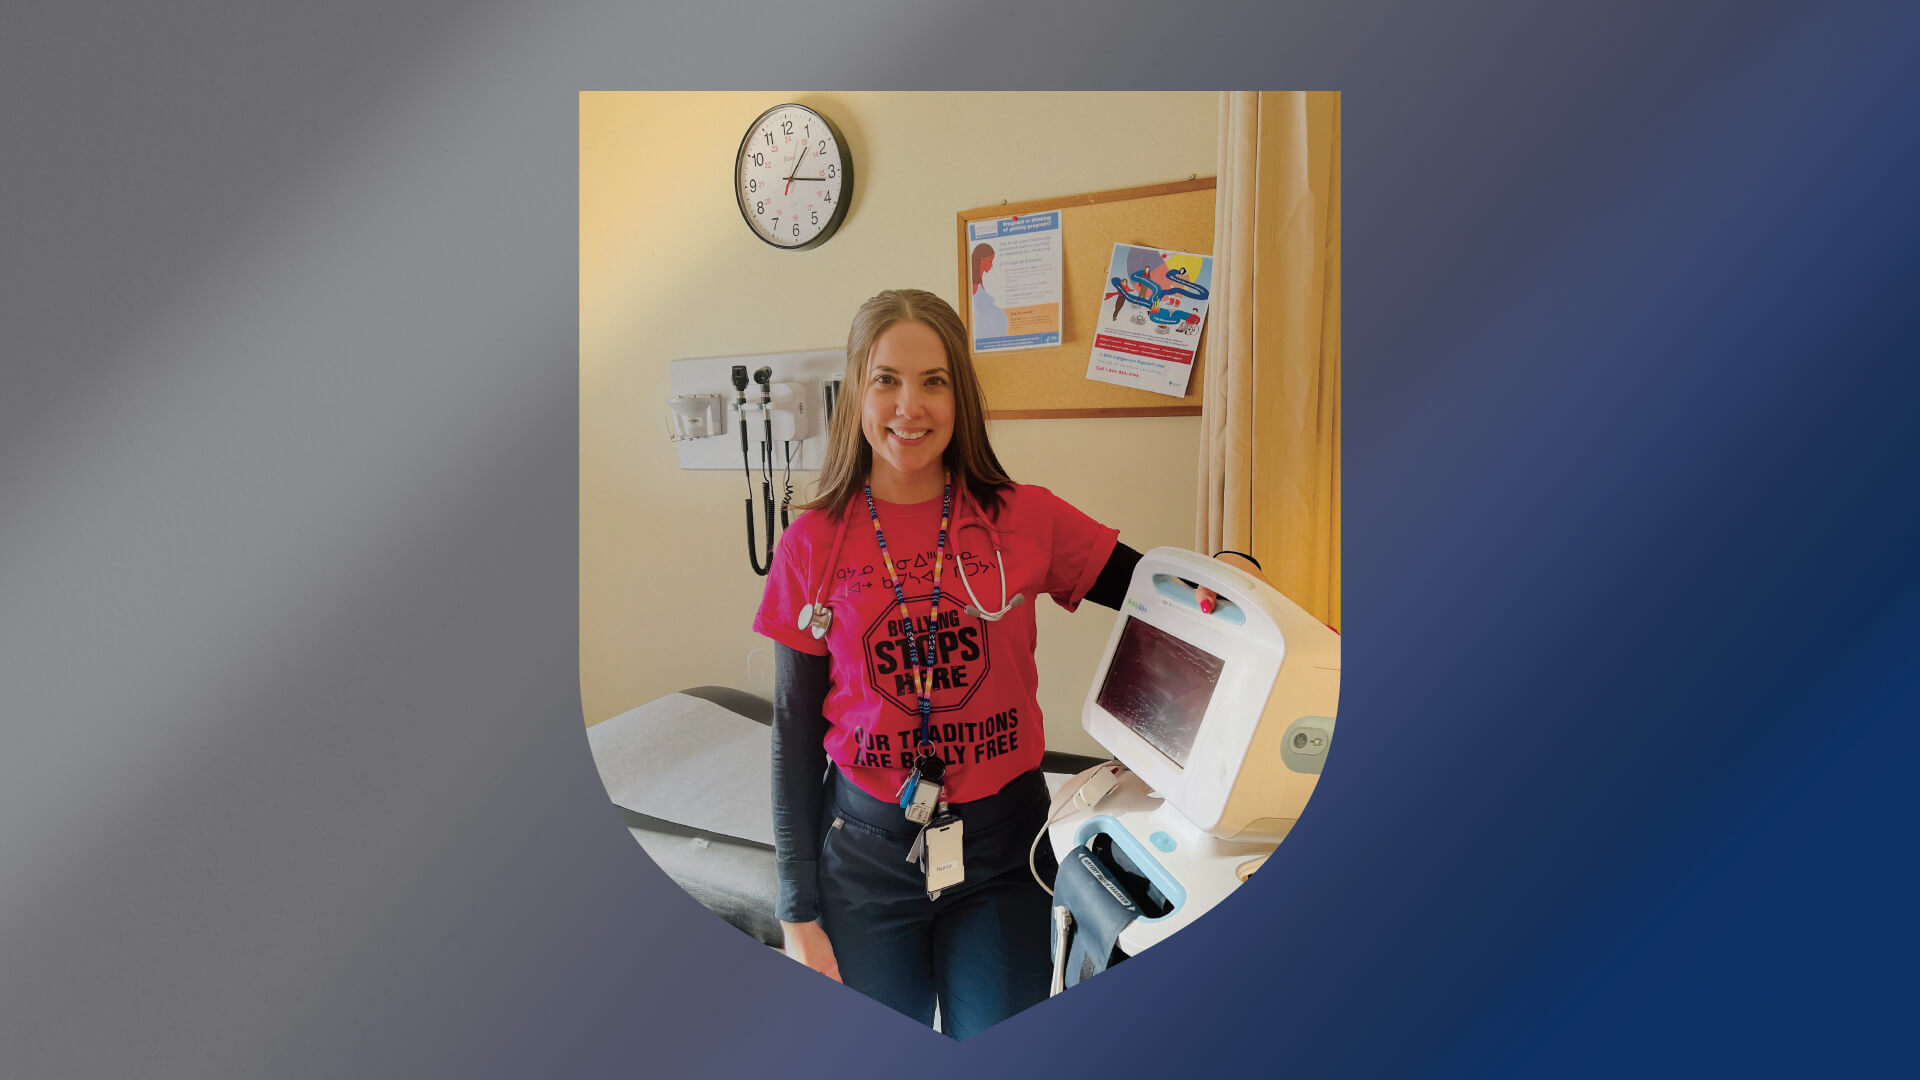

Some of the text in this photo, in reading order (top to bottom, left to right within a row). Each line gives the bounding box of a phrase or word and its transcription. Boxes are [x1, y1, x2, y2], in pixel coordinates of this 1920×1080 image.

[780, 120, 794, 136] 12
[804, 124, 810, 138] 1
[764, 131, 774, 146] 11
[818, 140, 827, 155] 2
[752, 152, 764, 167] 10
[827, 164, 836, 179] 3
[749, 179, 757, 193] 9
[823, 189, 832, 204] 4
[756, 201, 765, 215] 8
[771, 217, 779, 231] 7
[811, 211, 819, 225] 5
[792, 223, 800, 237] 6
[887, 609, 961, 637] BLLYNG
[874, 626, 980, 675] STOPS
[854, 707, 1019, 752] OUR TRADITIONS
[853, 731, 1019, 769] ARE BLY FREE
[936, 863, 953, 872] Nurse
